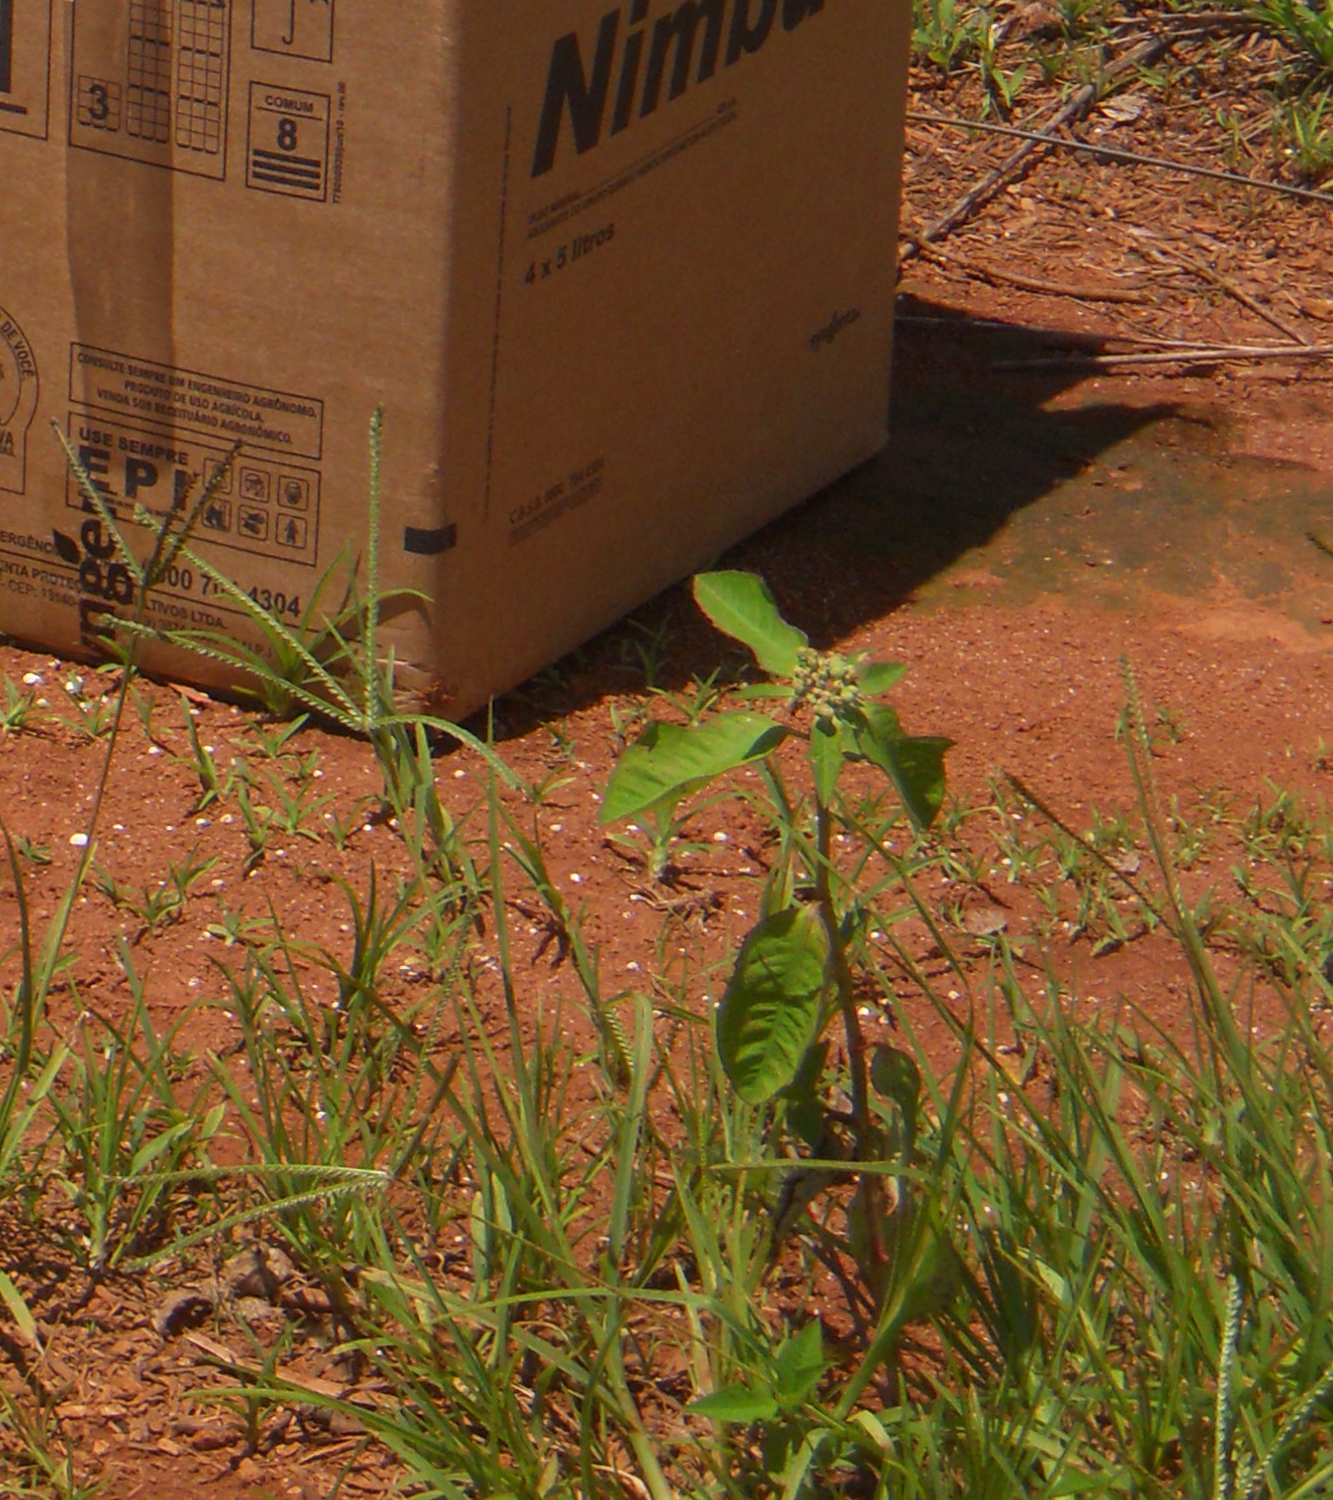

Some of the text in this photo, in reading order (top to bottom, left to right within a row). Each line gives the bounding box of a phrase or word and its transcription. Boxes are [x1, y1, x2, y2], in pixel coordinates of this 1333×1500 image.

[88, 84, 109, 119] 3
[265, 95, 313, 112] COMUM
[277, 118, 297, 151] 8
[524, 224, 614, 284] 4 x 5 litros
[2, 320, 18, 339] DE
[77, 352, 126, 374] CONSULTE
[128, 365, 166, 383] SEMPRE
[187, 379, 250, 404] ENGENHEIRO
[97, 388, 131, 406] VENDA
[133, 396, 151, 412] SOB
[125, 380, 171, 400] PRODUTO
[174, 391, 187, 404] DE
[189, 395, 210, 409] USO
[79, 427, 190, 466] USE SEMPRE
[190, 610, 228, 631] LTDA.
